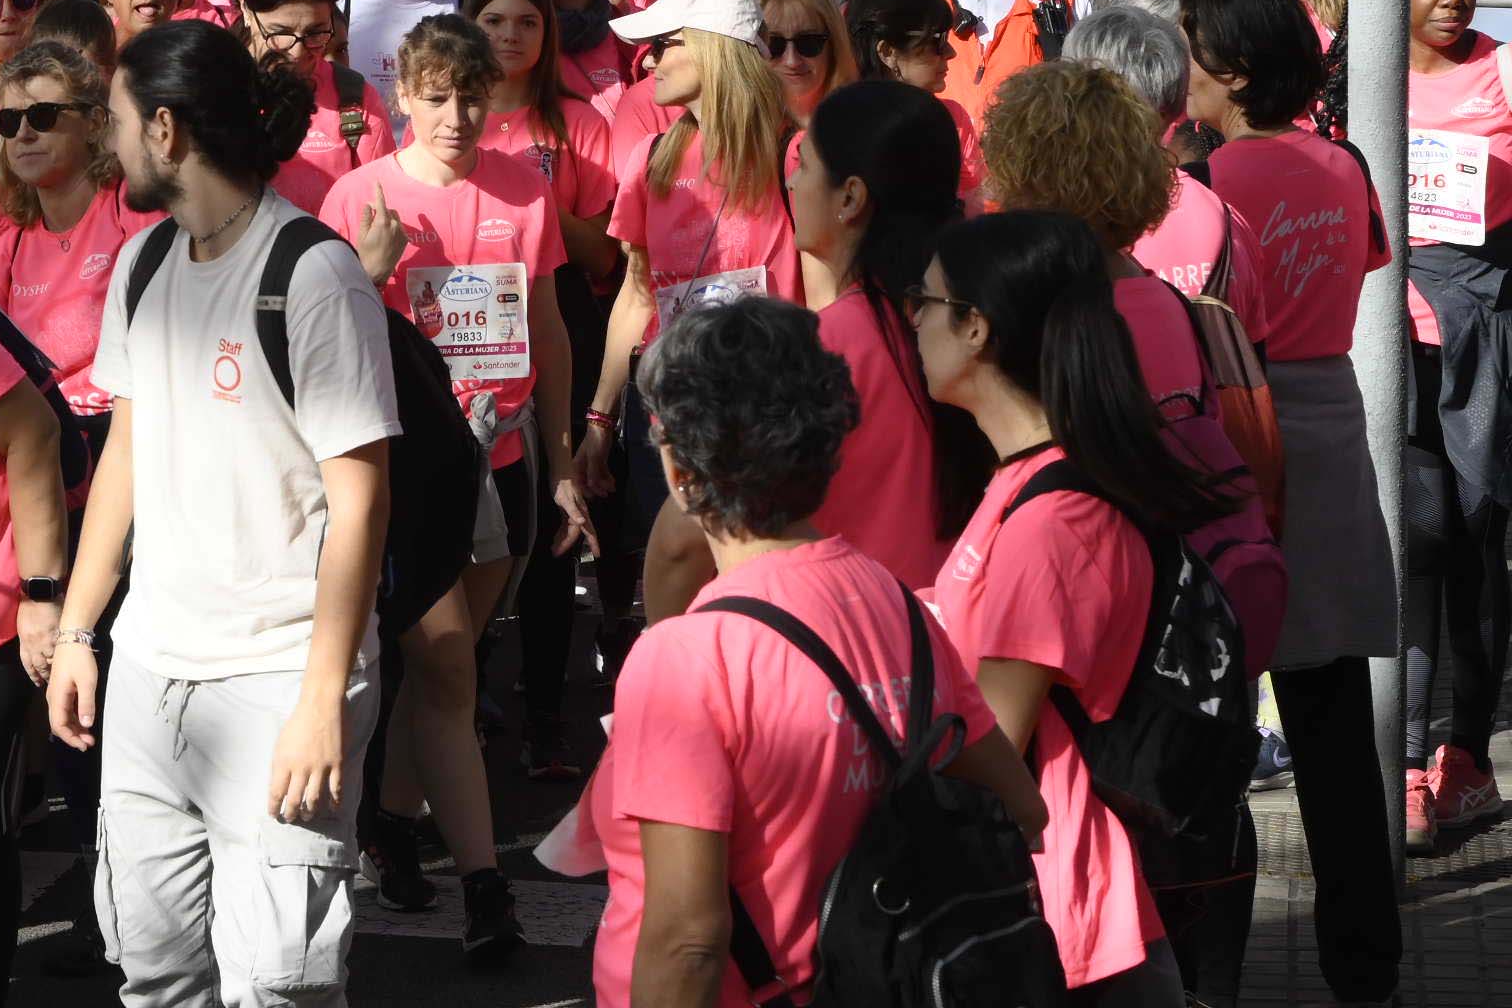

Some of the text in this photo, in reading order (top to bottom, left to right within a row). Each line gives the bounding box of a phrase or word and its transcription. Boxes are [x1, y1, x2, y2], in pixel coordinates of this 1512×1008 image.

[1260, 200, 1348, 247] Carrera
[407, 232, 437, 244] SHO
[1274, 238, 1334, 298] Mujer
[447, 310, 487, 328] 016
[450, 331, 483, 342] 19833
[218, 338, 243, 355] Staff
[465, 346, 475, 354] LA
[476, 346, 500, 354] MUJER
[483, 361, 521, 370] Santander
